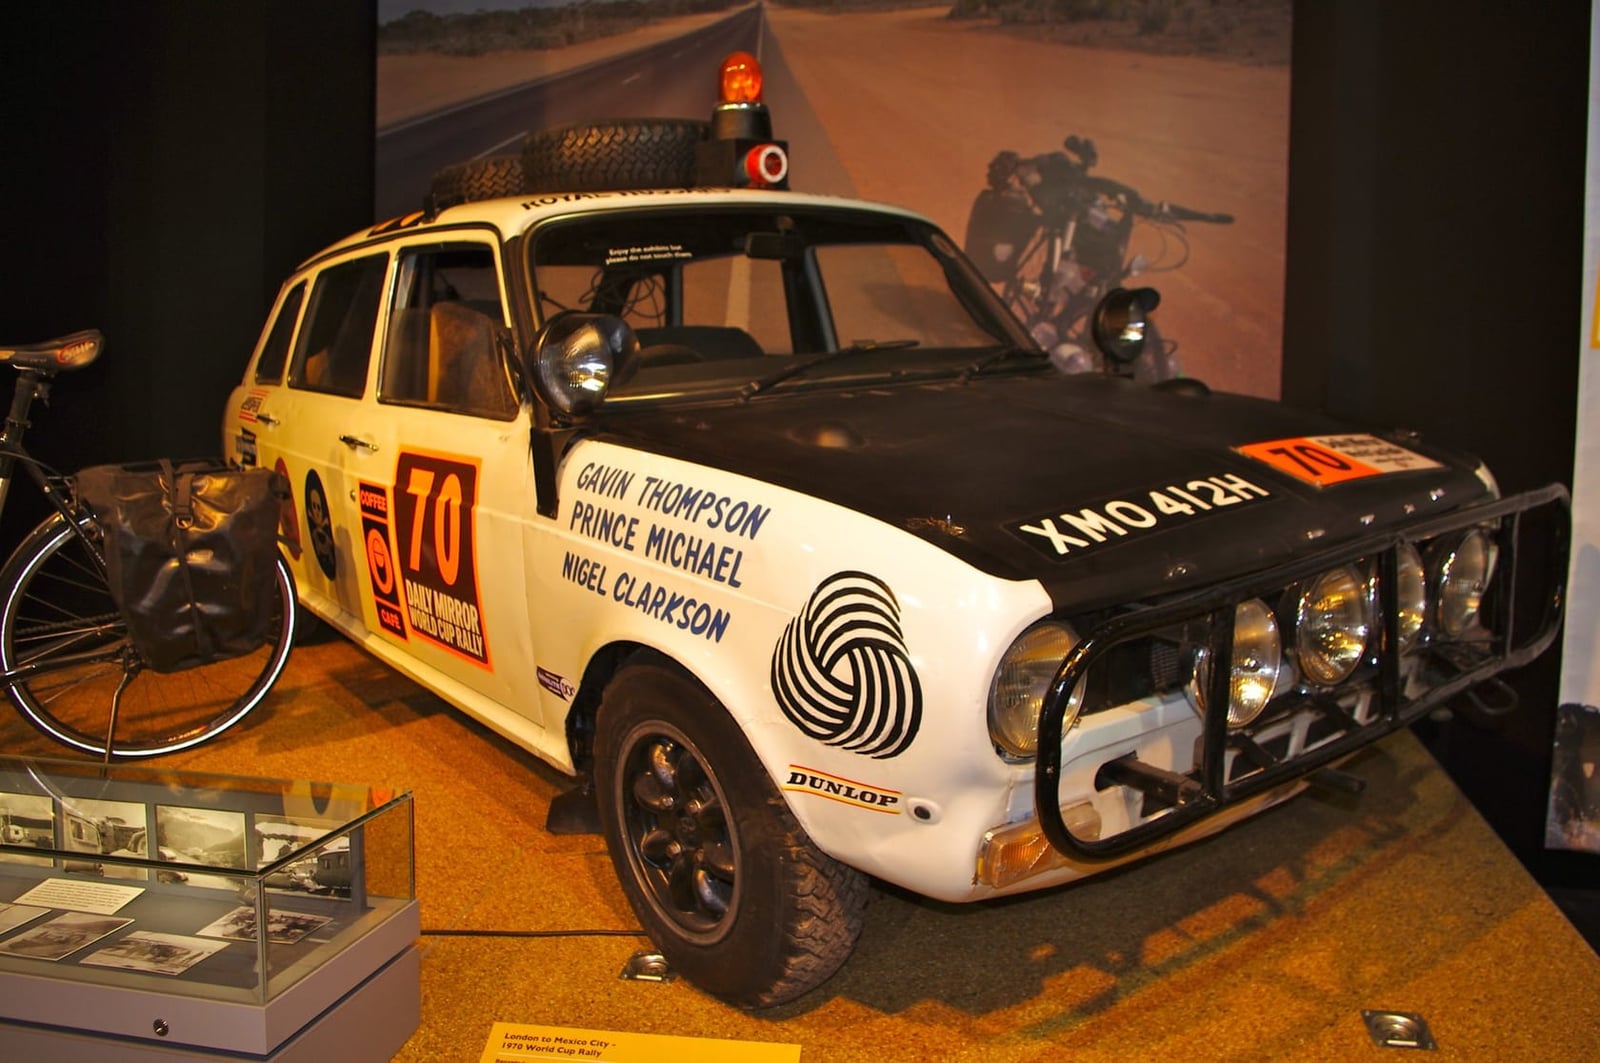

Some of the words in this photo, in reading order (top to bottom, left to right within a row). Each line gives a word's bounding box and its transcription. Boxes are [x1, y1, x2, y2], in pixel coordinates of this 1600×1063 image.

[1267, 446, 1351, 475] 70
[360, 489, 387, 511] COFFEE
[406, 467, 463, 586] 70
[577, 462, 636, 500] GAVIN
[637, 476, 772, 540] THOMPSON
[1019, 500, 1157, 555] XMO
[1149, 473, 1270, 517] 412H
[569, 500, 640, 551] PRINCE
[644, 523, 744, 588] MICHAEL
[405, 578, 433, 614] DAILY
[433, 589, 480, 635] MIRROR
[562, 551, 607, 597] NIGEL
[612, 572, 731, 643] CLARKSON
[409, 605, 438, 637] WORLD
[438, 619, 455, 645] CUP
[455, 626, 483, 658] RALLY
[787, 772, 899, 806] DUNLOP
[502, 1042, 523, 1050] 1970
[526, 1044, 555, 1053] World
[556, 1046, 576, 1055] Cup
[578, 1048, 602, 1058] Rally
[504, 1032, 539, 1042] London
[554, 1037, 588, 1046] Mexico
[589, 1039, 609, 1048] City
